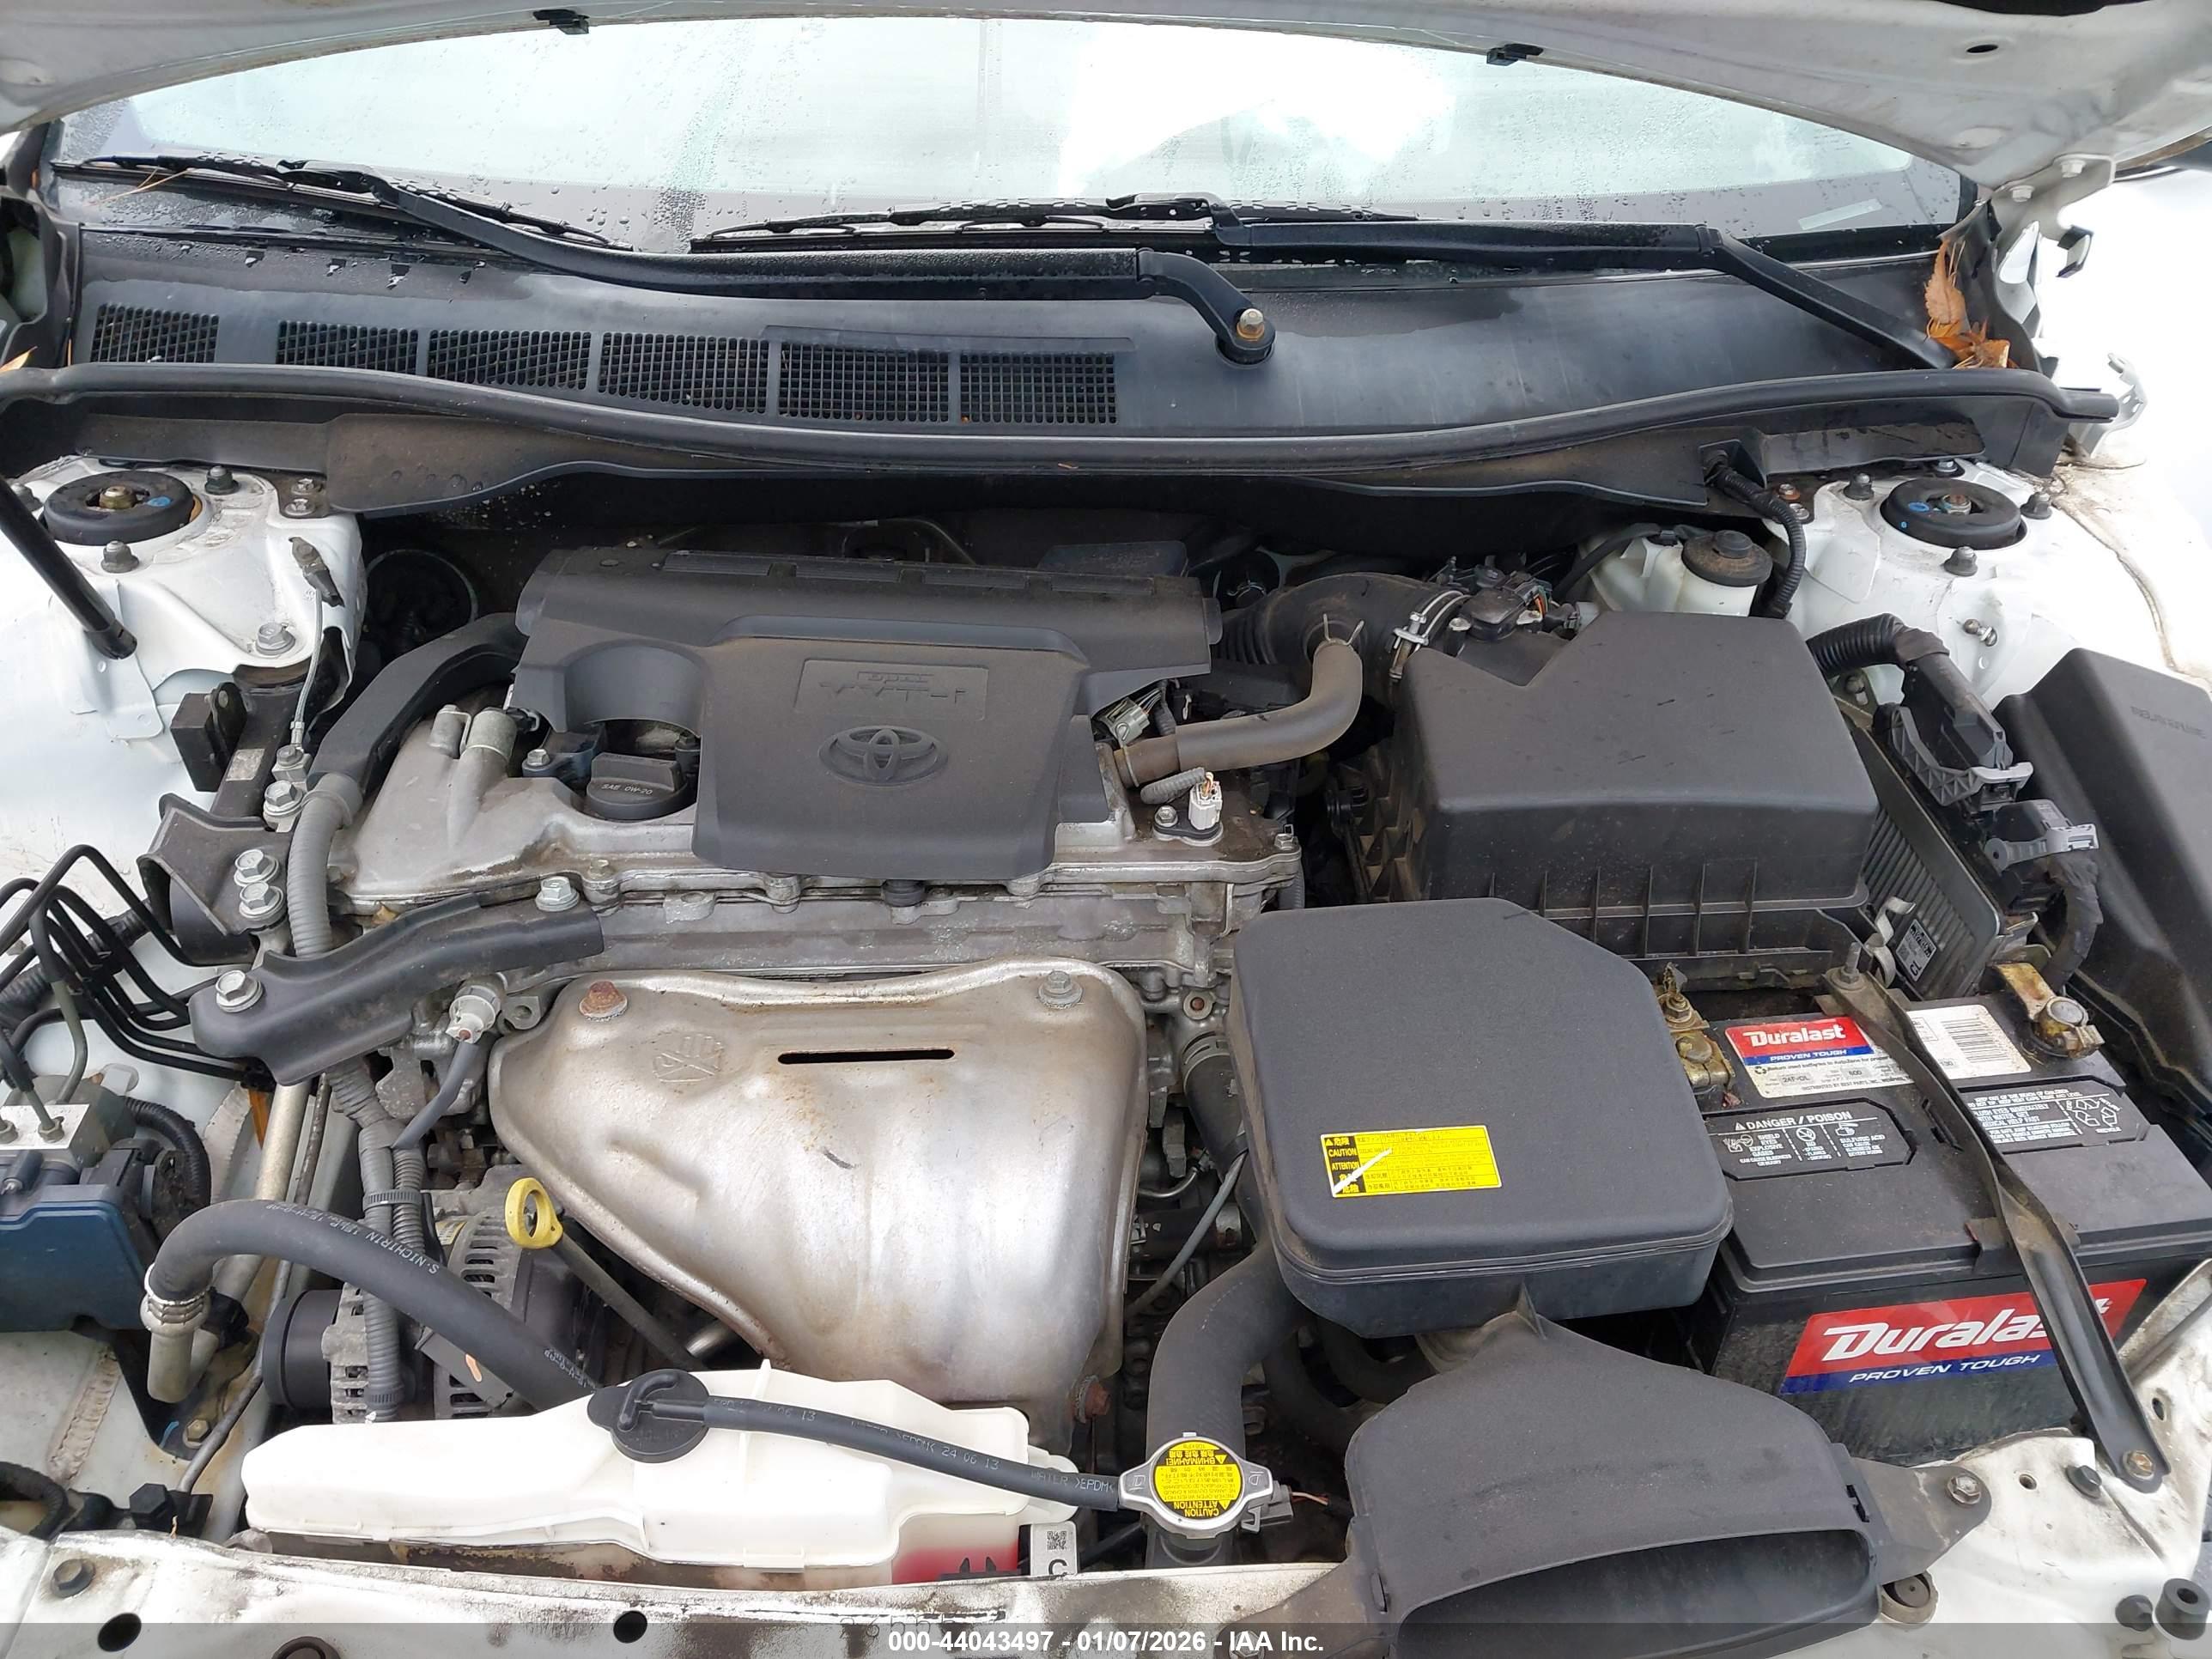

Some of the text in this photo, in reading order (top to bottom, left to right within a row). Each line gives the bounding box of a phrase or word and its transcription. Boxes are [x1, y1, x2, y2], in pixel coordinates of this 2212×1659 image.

[601, 782, 653, 796] SAE 0W-20
[1742, 1024, 1846, 1048] Duralast
[1769, 1048, 1847, 1062] PROVEN TOUGH
[1746, 1117, 1796, 1131] DANGER
[1807, 1111, 1853, 1124] POISON
[1328, 1147, 1358, 1158] CAUTION
[1332, 1161, 1359, 1170] ATTENTION
[1822, 1297, 2110, 1362] Durala
[1849, 1353, 2040, 1383] PROVEN TOUGH
[941, 1445, 957, 1459] 24
[984, 1458, 1000, 1471] 13
[1165, 1456, 1216, 1466] ВНИМАНИЕ!
[1173, 1500, 1218, 1510] ATTENTION
[1184, 1509, 1219, 1517] CAUTION
